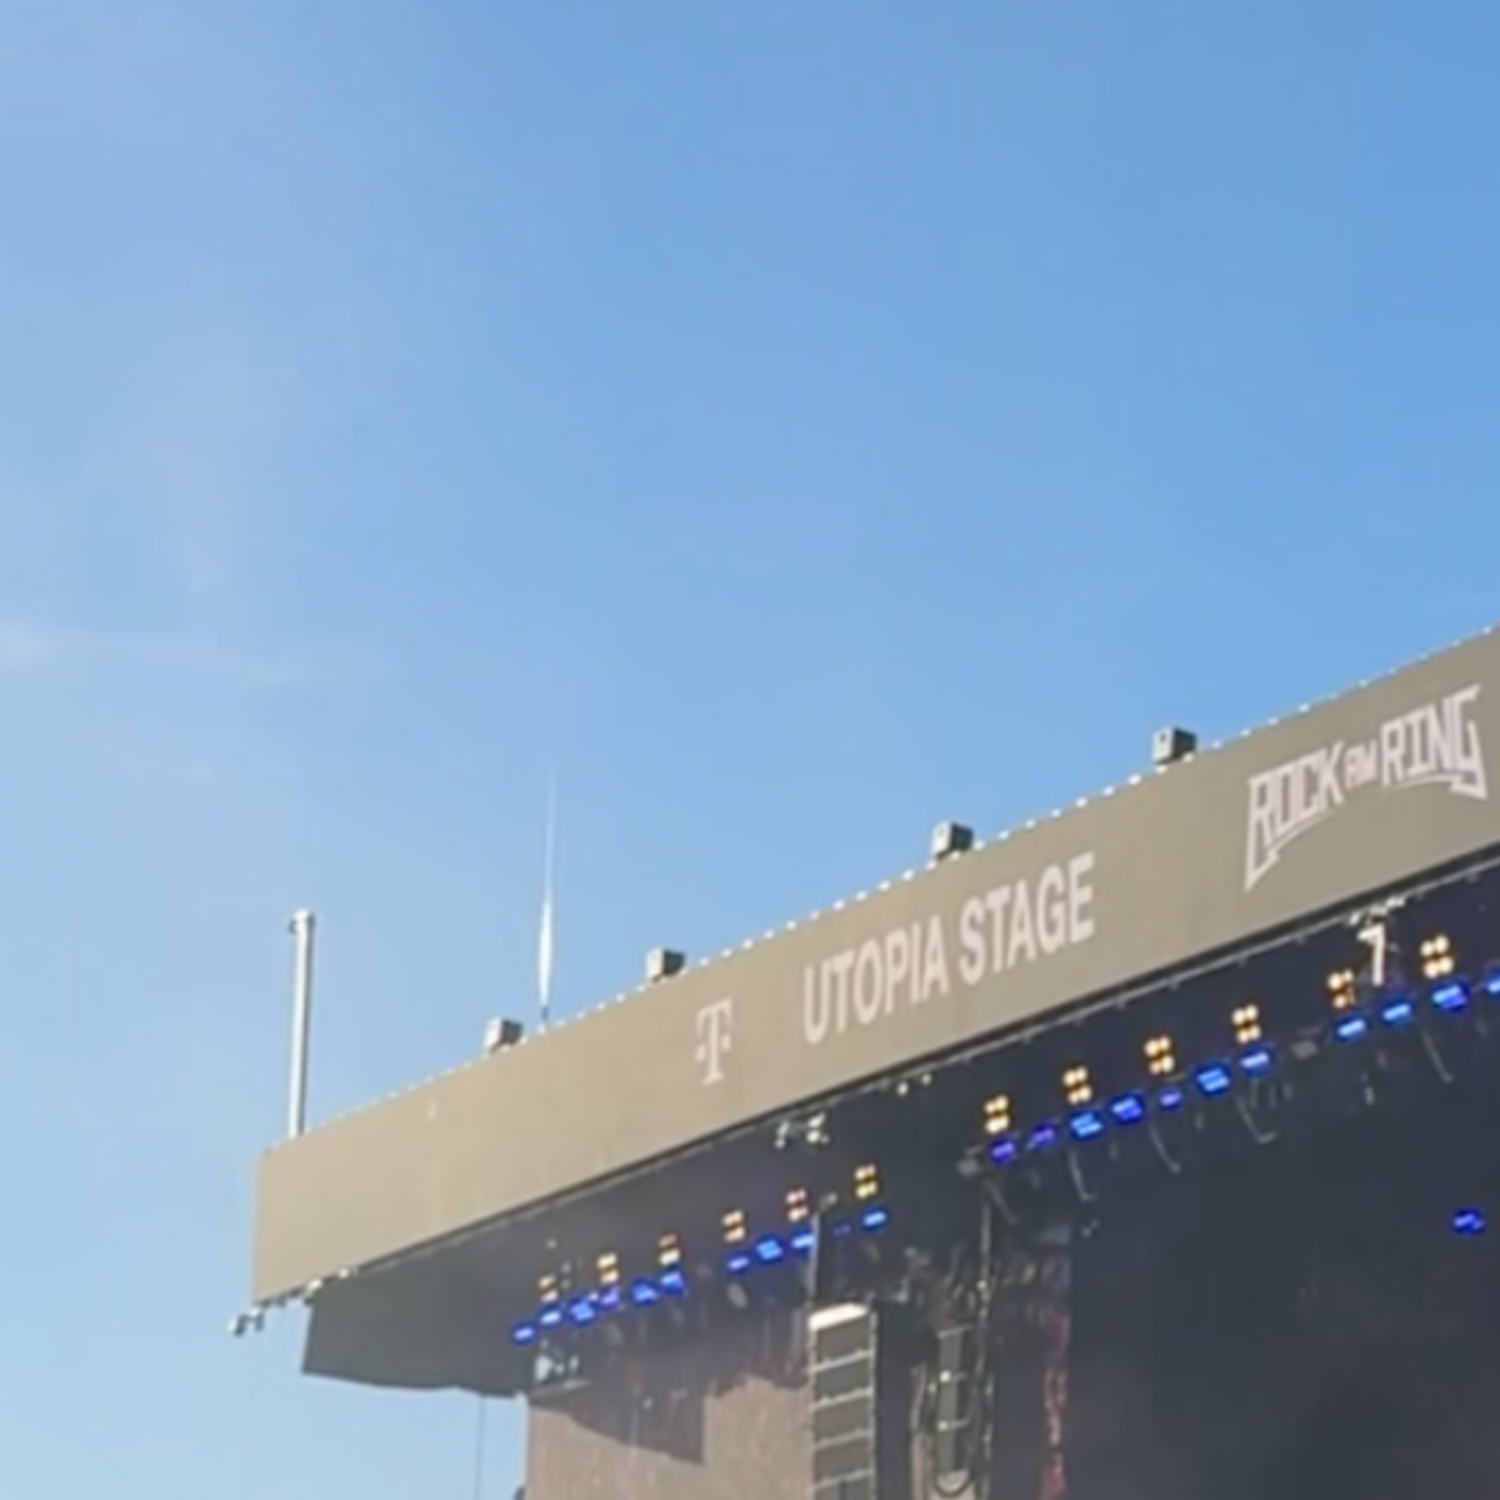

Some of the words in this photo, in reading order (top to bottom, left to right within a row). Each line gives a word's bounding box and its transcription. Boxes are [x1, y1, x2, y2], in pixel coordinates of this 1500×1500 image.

[1245, 738, 1345, 893] ROCK
[1381, 683, 1488, 800] RING
[802, 915, 950, 1045] UTOPIA
[958, 851, 1096, 985] STAGE
